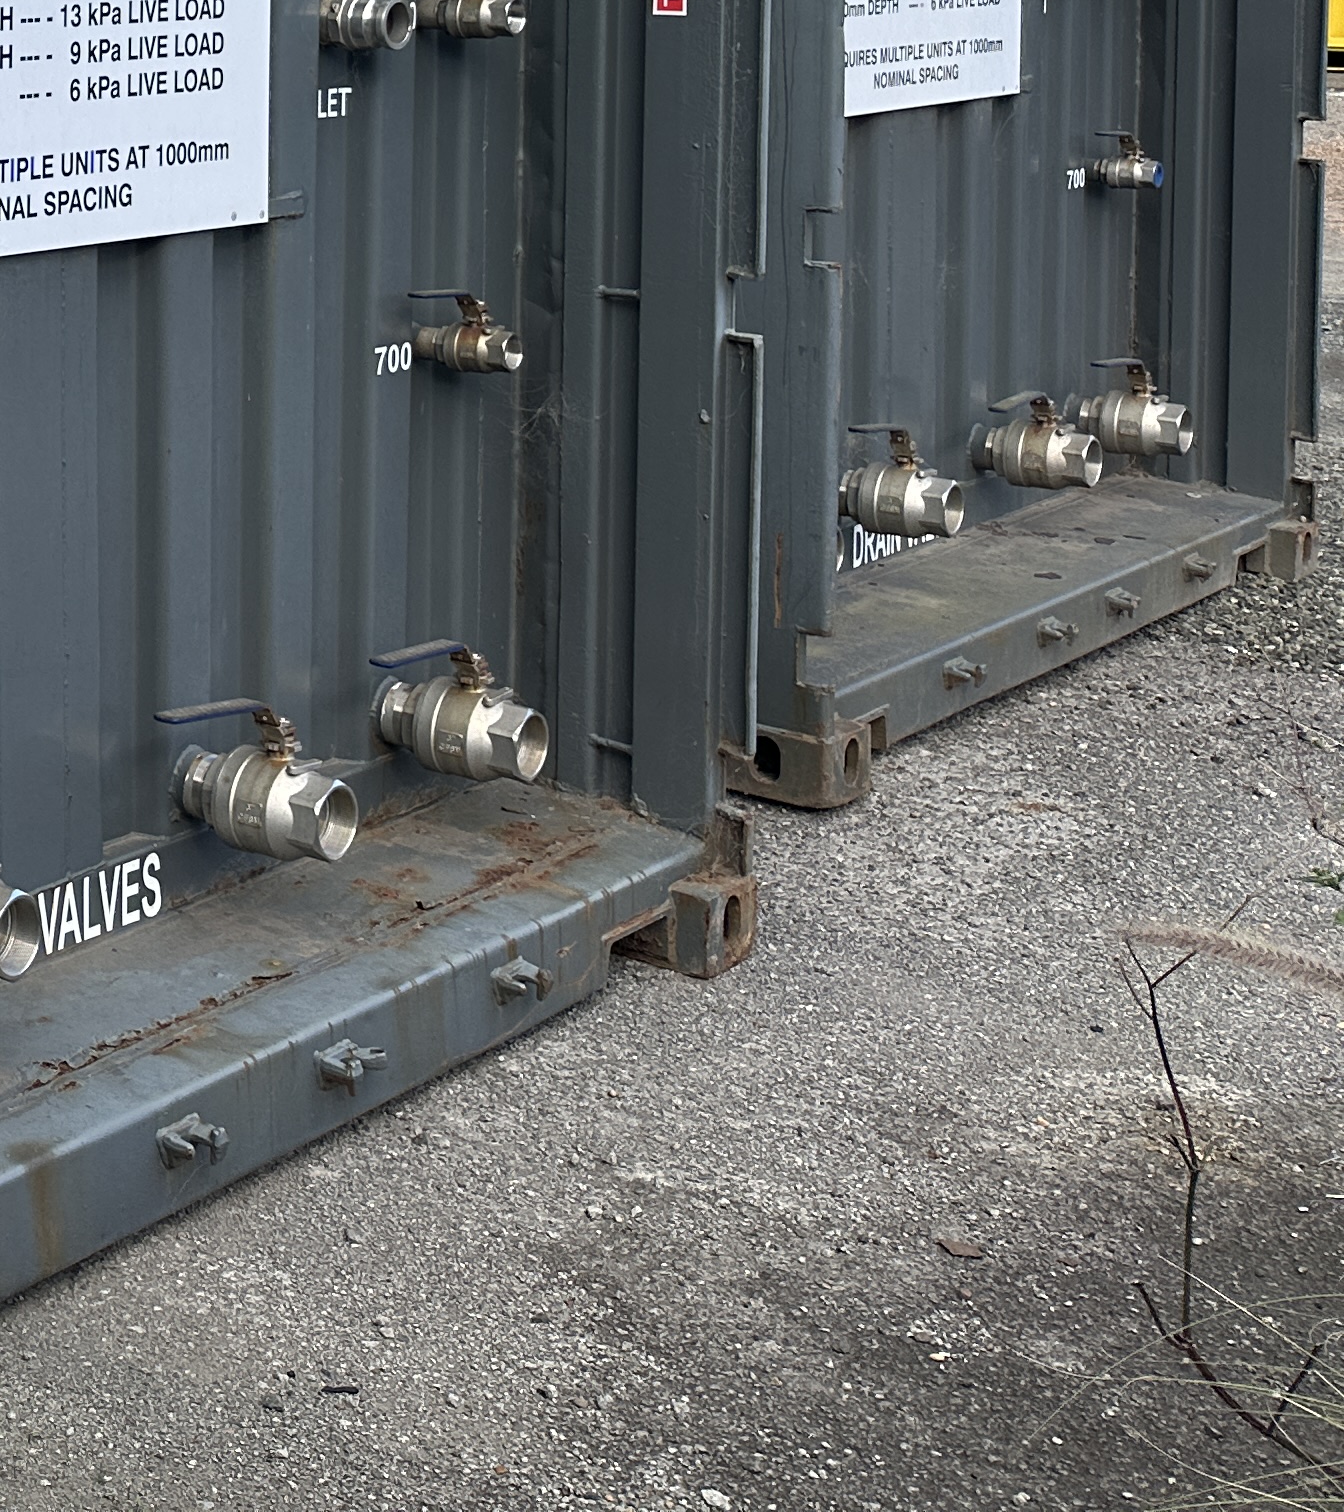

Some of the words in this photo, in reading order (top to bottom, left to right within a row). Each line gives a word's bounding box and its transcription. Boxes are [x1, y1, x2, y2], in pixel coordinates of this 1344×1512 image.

[60, 4, 82, 28] 13
[88, 1, 122, 26] kPa
[70, 41, 81, 65] 9
[87, 38, 121, 64] kPa
[127, 34, 168, 61] LIVE
[174, 31, 224, 58] LOAD
[879, 44, 925, 64] MULTIPLE
[926, 41, 954, 59] UNITS
[955, 40, 968, 55] AT
[969, 38, 1003, 55] 1000mm
[69, 78, 81, 102] 6
[87, 75, 121, 101] kPa
[127, 71, 168, 97] LIVE
[174, 67, 224, 94] LOAD
[873, 70, 917, 89] NOMINAL
[918, 64, 959, 84] SPACING
[317, 86, 353, 119] LET
[61, 147, 120, 177] UNITS
[125, 144, 150, 171] AT
[156, 141, 229, 167] 1000mm
[1066, 167, 1086, 190] 700
[43, 182, 132, 217] SPACING
[374, 341, 413, 376] 700
[37, 851, 163, 956] VALVES
